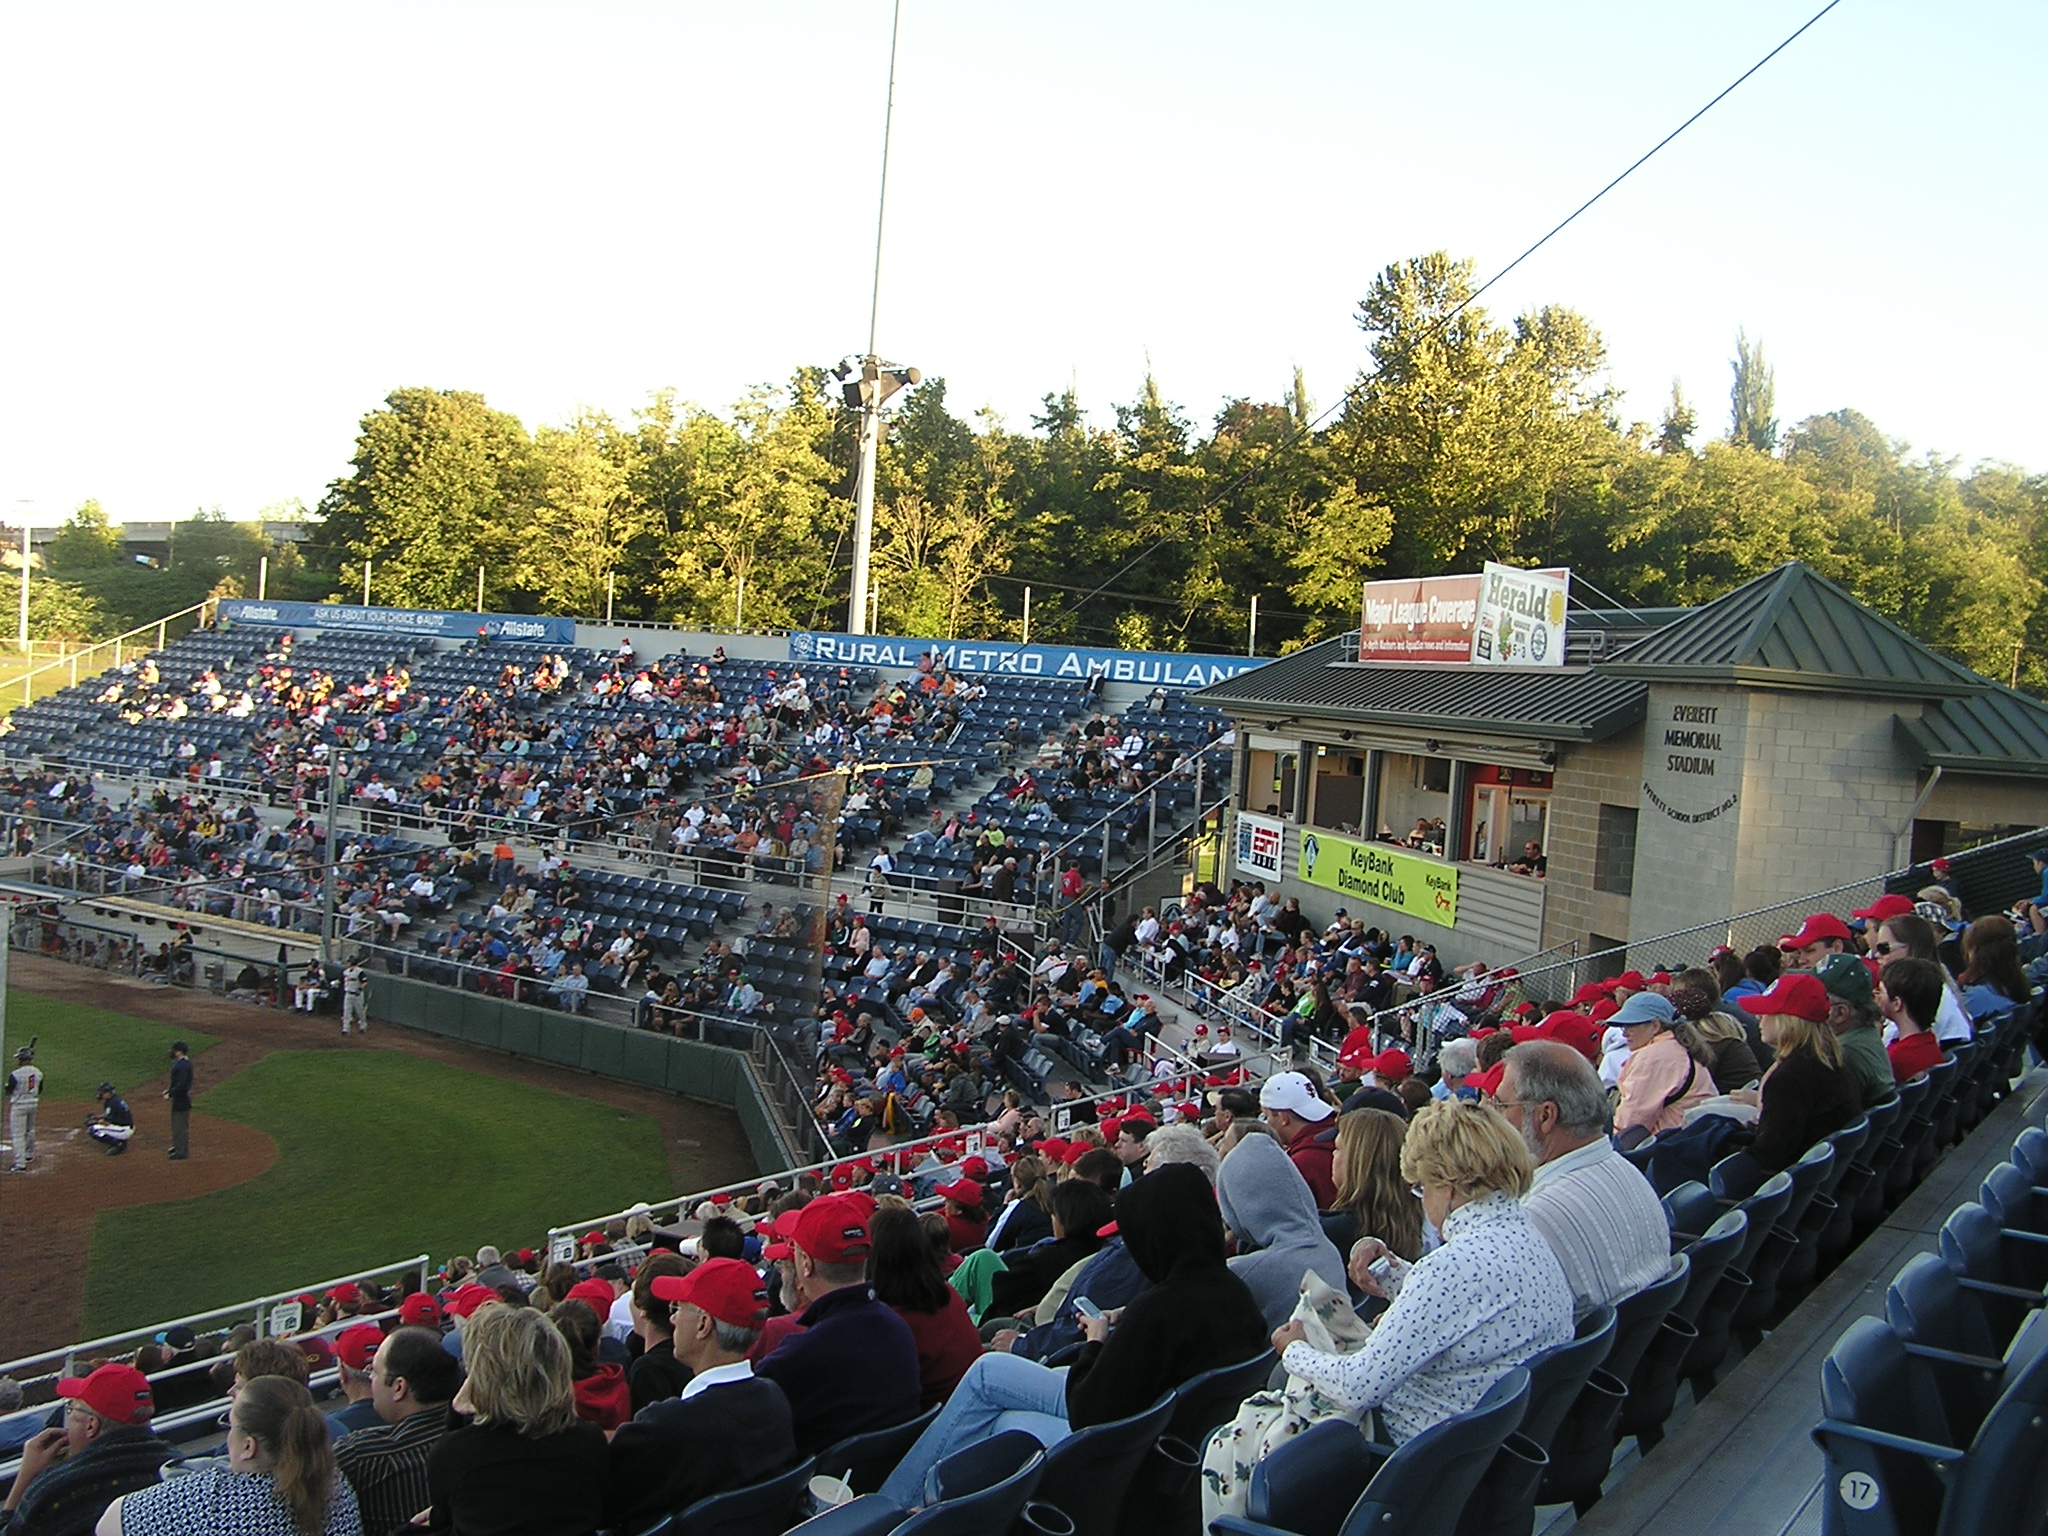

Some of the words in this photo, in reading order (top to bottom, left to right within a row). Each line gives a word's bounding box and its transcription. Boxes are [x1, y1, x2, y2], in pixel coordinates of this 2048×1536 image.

[1487, 573, 1548, 622] Herald
[240, 605, 279, 620] Allstate
[314, 609, 329, 619] ASK
[330, 610, 341, 620] US
[341, 610, 366, 621] ABOUT
[367, 612, 387, 623] YOUR
[388, 613, 415, 625] CHOICE
[1365, 598, 1392, 632] Major
[1392, 597, 1428, 632] League
[1429, 594, 1477, 631] Coverage
[499, 620, 545, 638] Allstate
[816, 637, 914, 666] RURAL
[931, 644, 1042, 674] METRO
[1057, 652, 1253, 685] AMBULAN
[1672, 705, 1719, 724] EVERETT
[1664, 729, 1723, 751] MEMORIAL
[1667, 754, 1715, 776] STADIUM
[1643, 783, 1666, 812] EVERETT
[1667, 807, 1692, 824] SCHOOL
[1692, 806, 1721, 824] DISTRICT
[1253, 836, 1279, 856] ESPN
[1252, 852, 1277, 871] RADIO
[1350, 846, 1394, 877] KeyBank
[1338, 867, 1380, 898] Diamond
[1382, 880, 1406, 906] Club
[1426, 874, 1451, 892] KeyBank
[1851, 1480, 1870, 1500] 17
